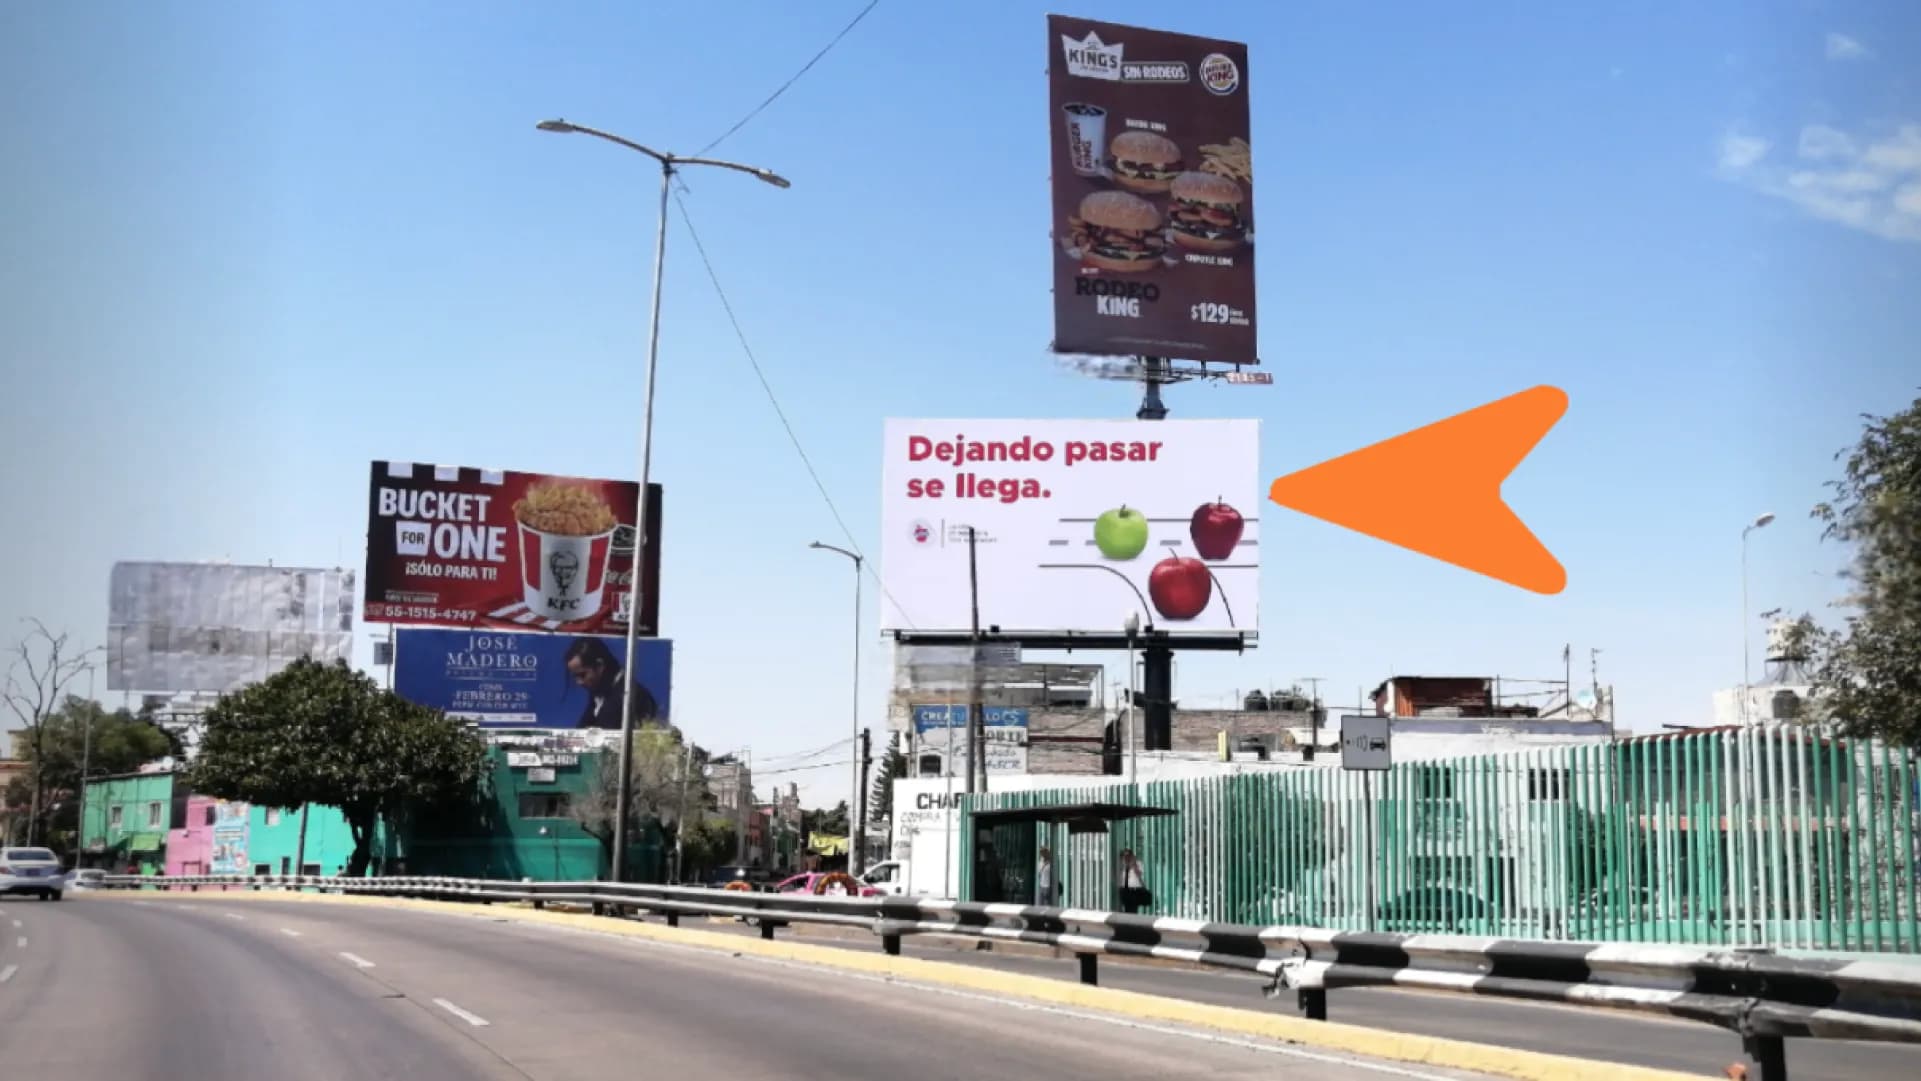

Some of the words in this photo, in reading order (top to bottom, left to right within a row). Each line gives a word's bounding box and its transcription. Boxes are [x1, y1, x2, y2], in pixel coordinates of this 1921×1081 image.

[1075, 276, 1160, 301] RODEO
[1096, 295, 1140, 317] KING
[1190, 302, 1230, 324] $129
[908, 435, 1054, 467] Dejando
[1065, 440, 1163, 466] pasar
[907, 477, 945, 499] se
[955, 473, 1052, 503] llega.
[378, 487, 491, 522] BUCKET
[401, 530, 426, 545] FOR
[433, 523, 507, 562] ONE
[405, 560, 442, 577] ¡SÓLO
[445, 563, 479, 580] PARA
[481, 566, 497, 581] TI!
[548, 597, 581, 611] KFC
[447, 652, 538, 668] MADERO
